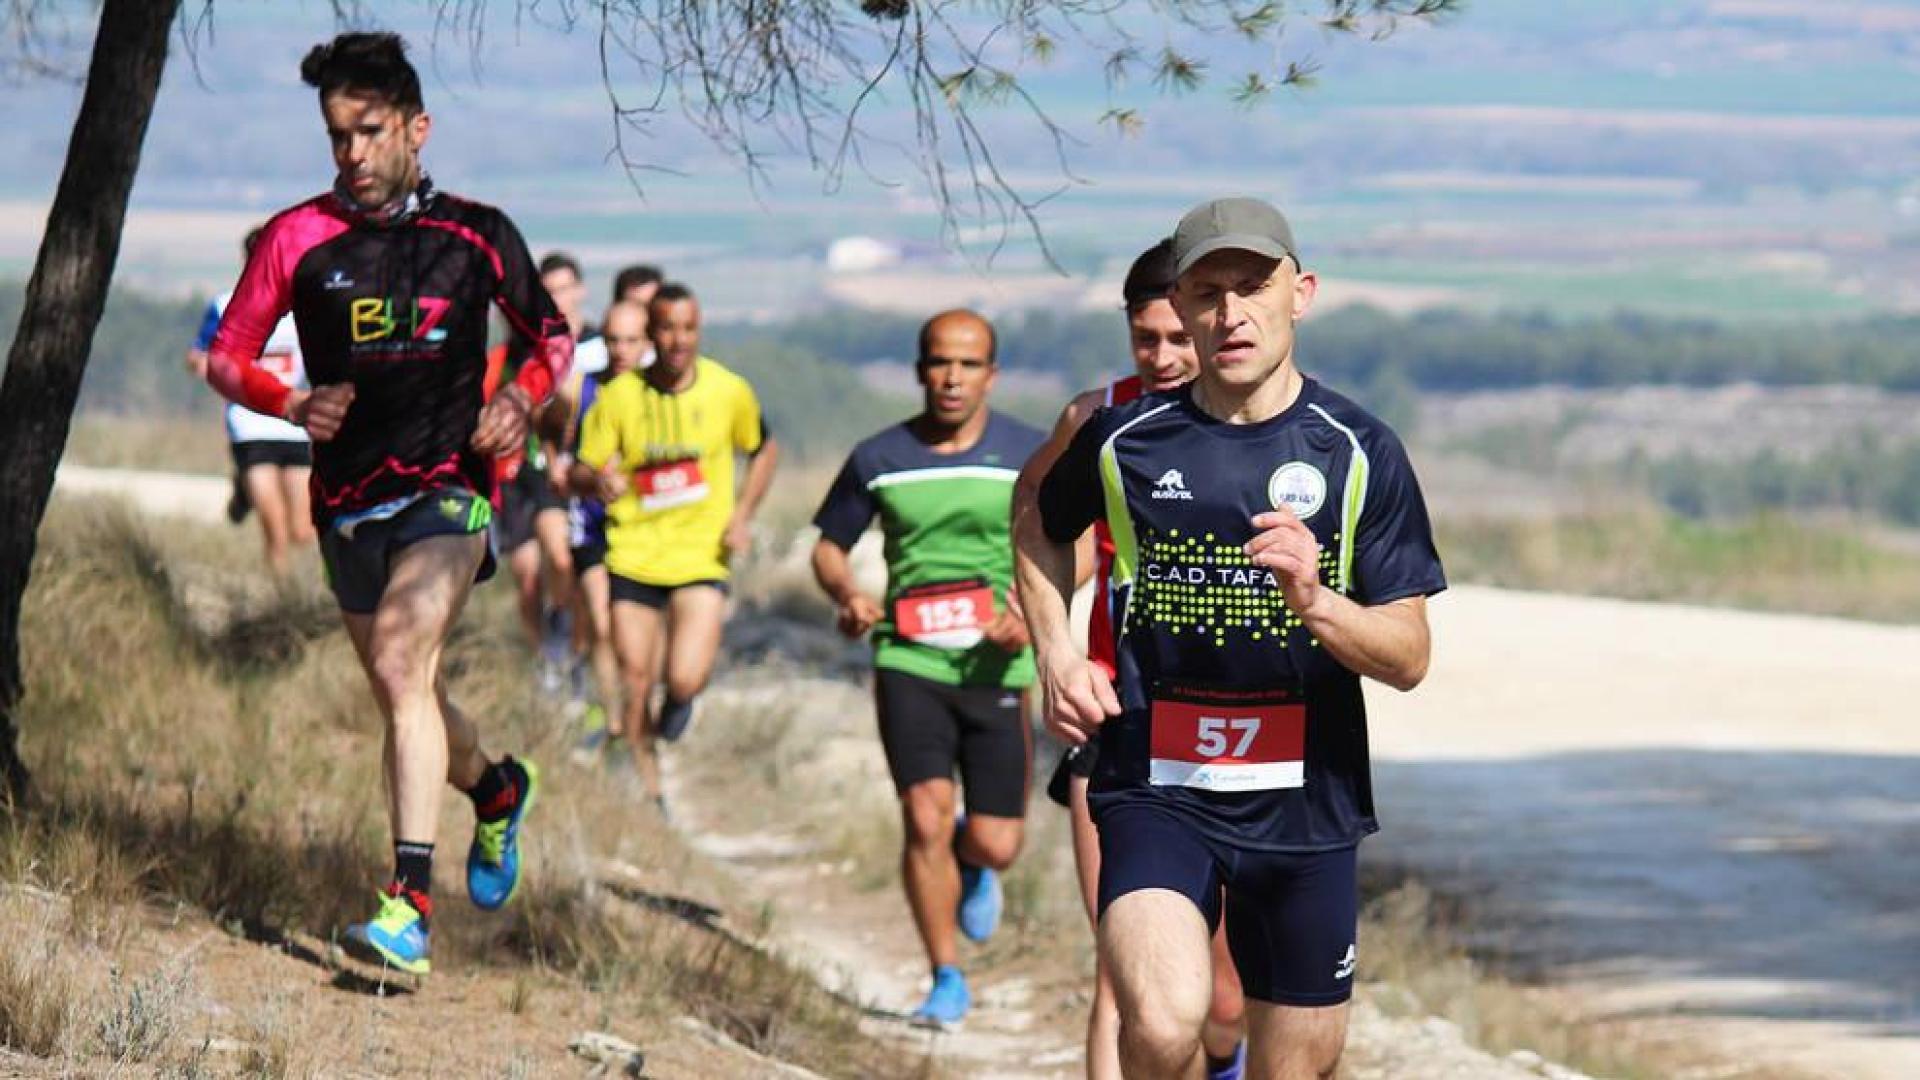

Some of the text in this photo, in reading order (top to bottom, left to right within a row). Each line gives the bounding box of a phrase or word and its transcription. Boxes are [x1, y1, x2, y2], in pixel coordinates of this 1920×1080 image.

[1147, 564, 1277, 587] C.A.D. TAFA
[916, 597, 977, 632] 152
[1194, 716, 1261, 757] 57
